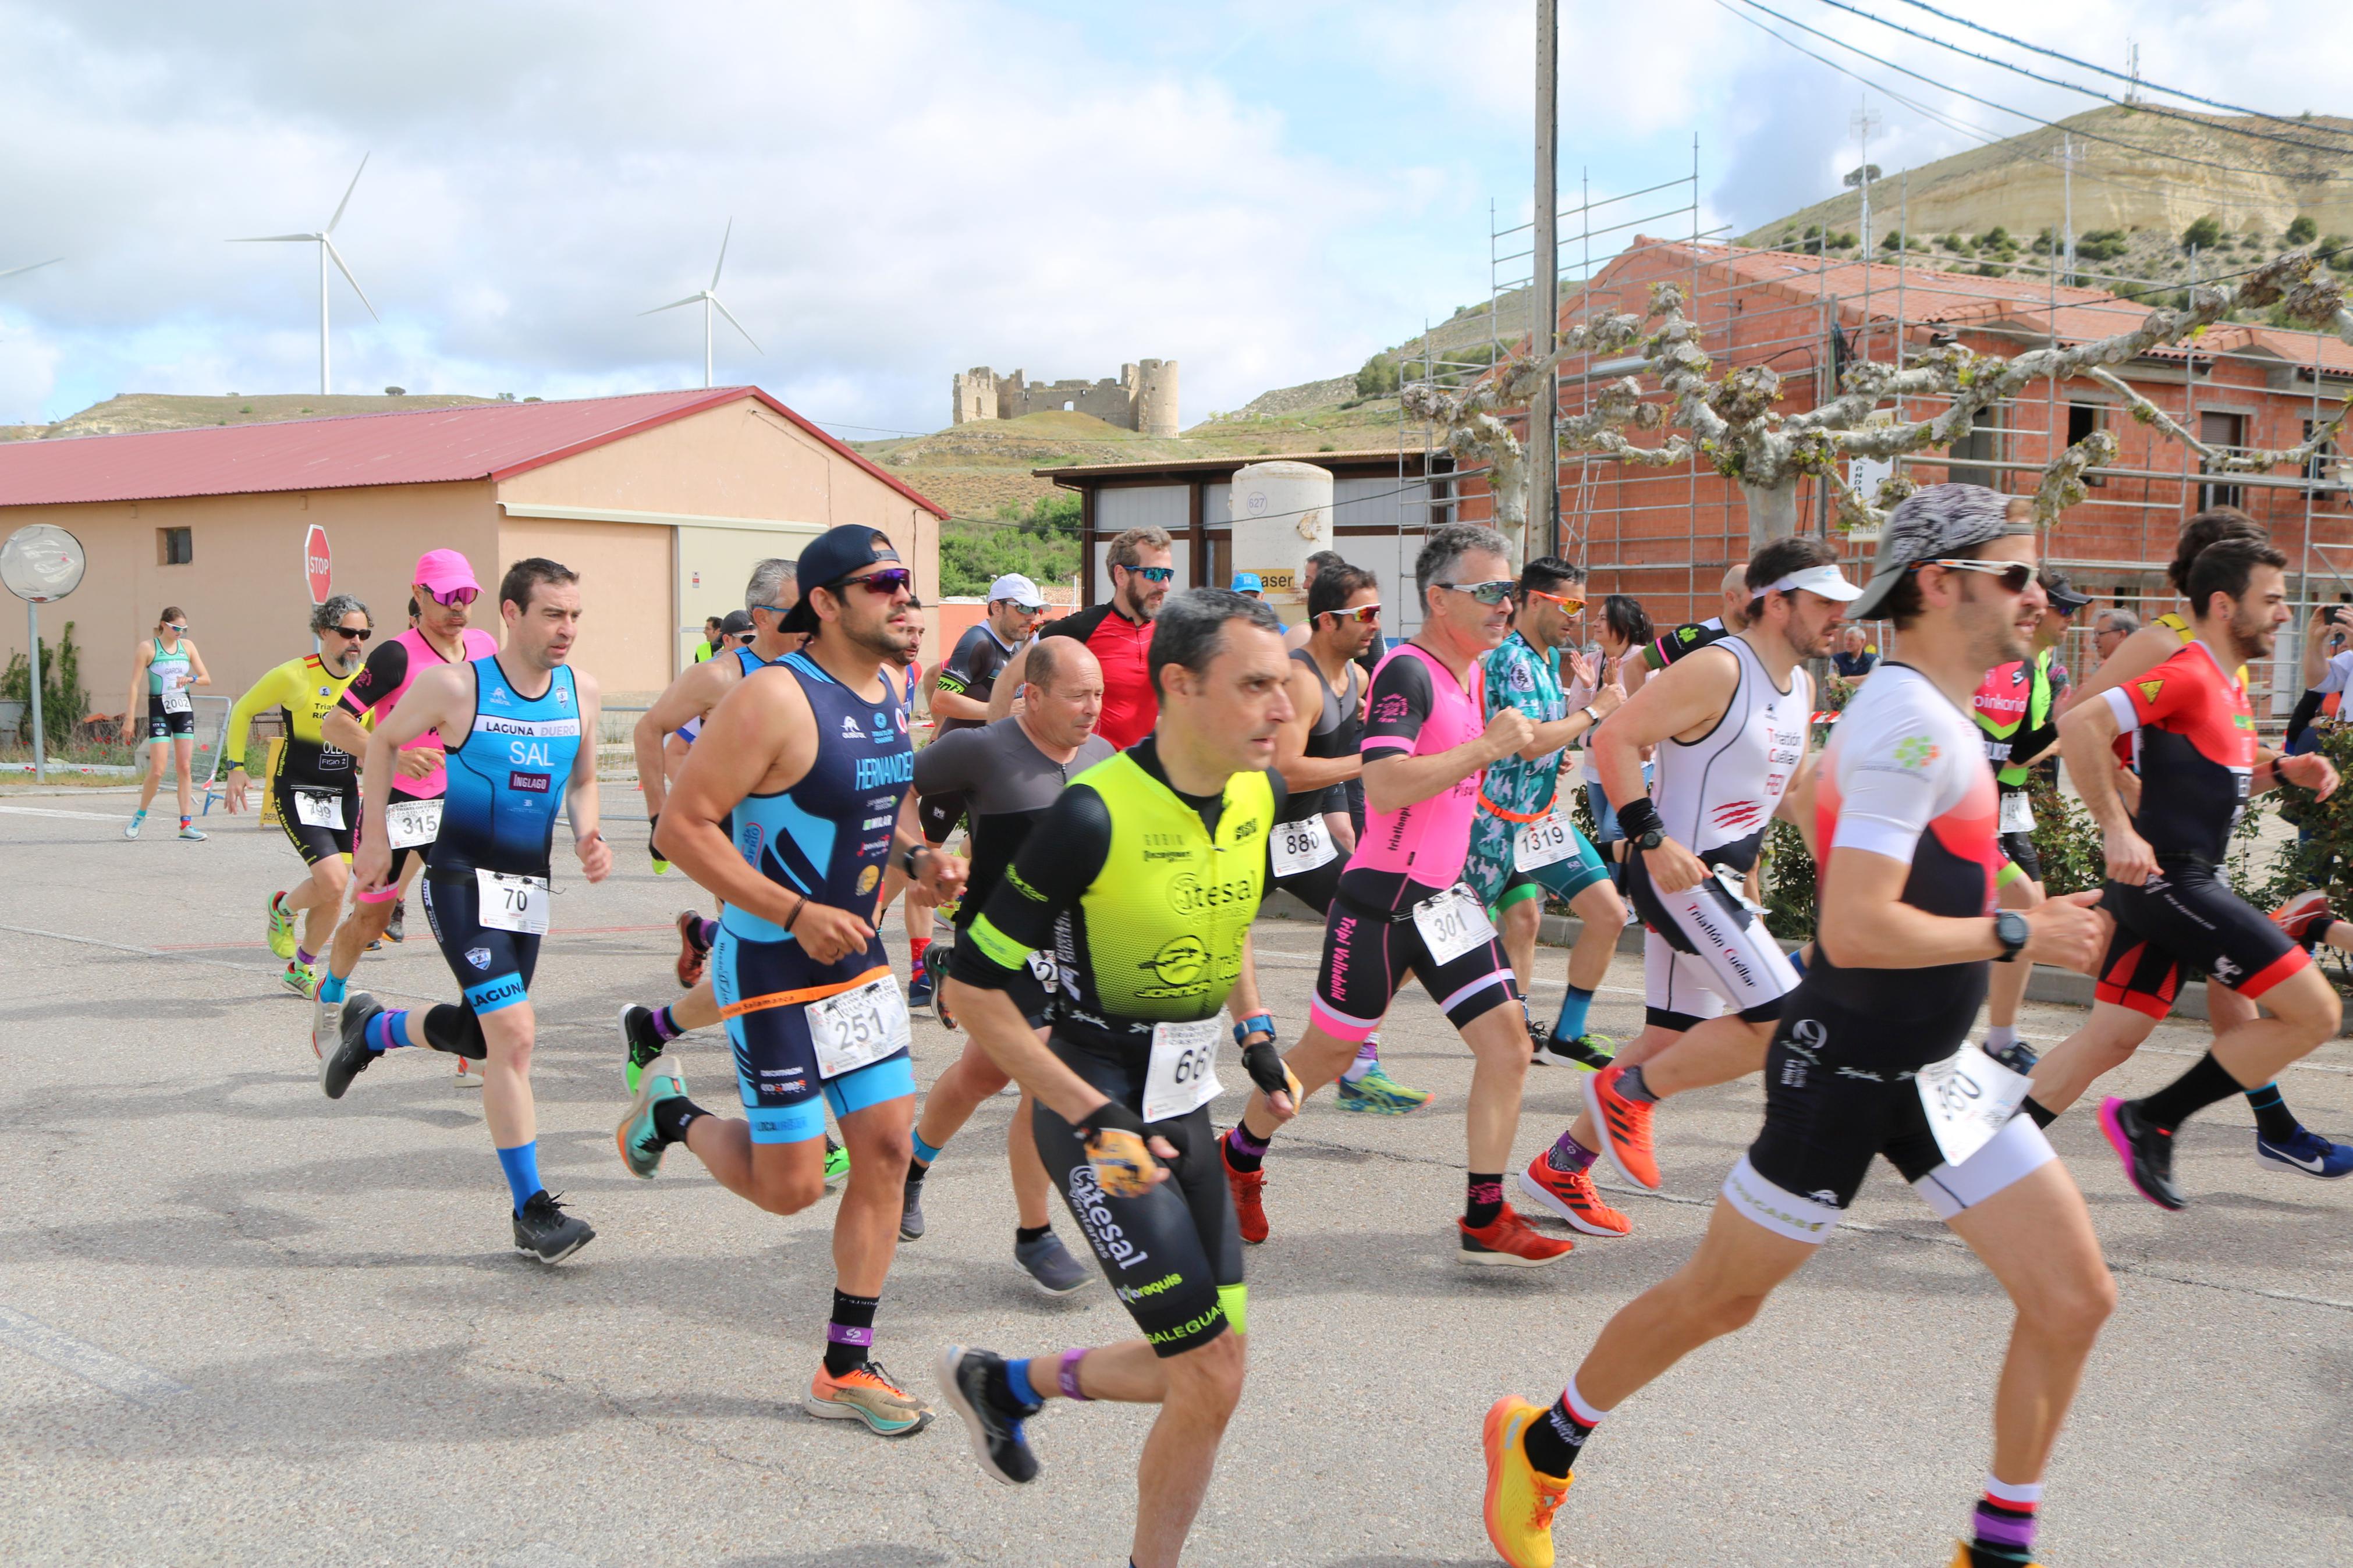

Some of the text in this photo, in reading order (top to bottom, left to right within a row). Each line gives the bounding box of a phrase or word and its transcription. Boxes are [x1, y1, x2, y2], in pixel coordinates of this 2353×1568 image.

[1248, 497, 1265, 509] 627
[310, 555, 329, 575] STOP
[1261, 575, 1293, 588] aser
[164, 698, 189, 709] 2002
[486, 721, 534, 736] LAGUNA
[509, 741, 555, 766] SAL
[403, 815, 437, 834] 315
[1287, 831, 1319, 855] 880
[1521, 826, 1564, 854] 1319
[503, 888, 527, 911] 70
[1435, 910, 1468, 943] 301
[1686, 902, 1758, 988] Triatlón Cuéllar
[1330, 946, 1351, 1002] Valladolid
[835, 1007, 886, 1051] 251
